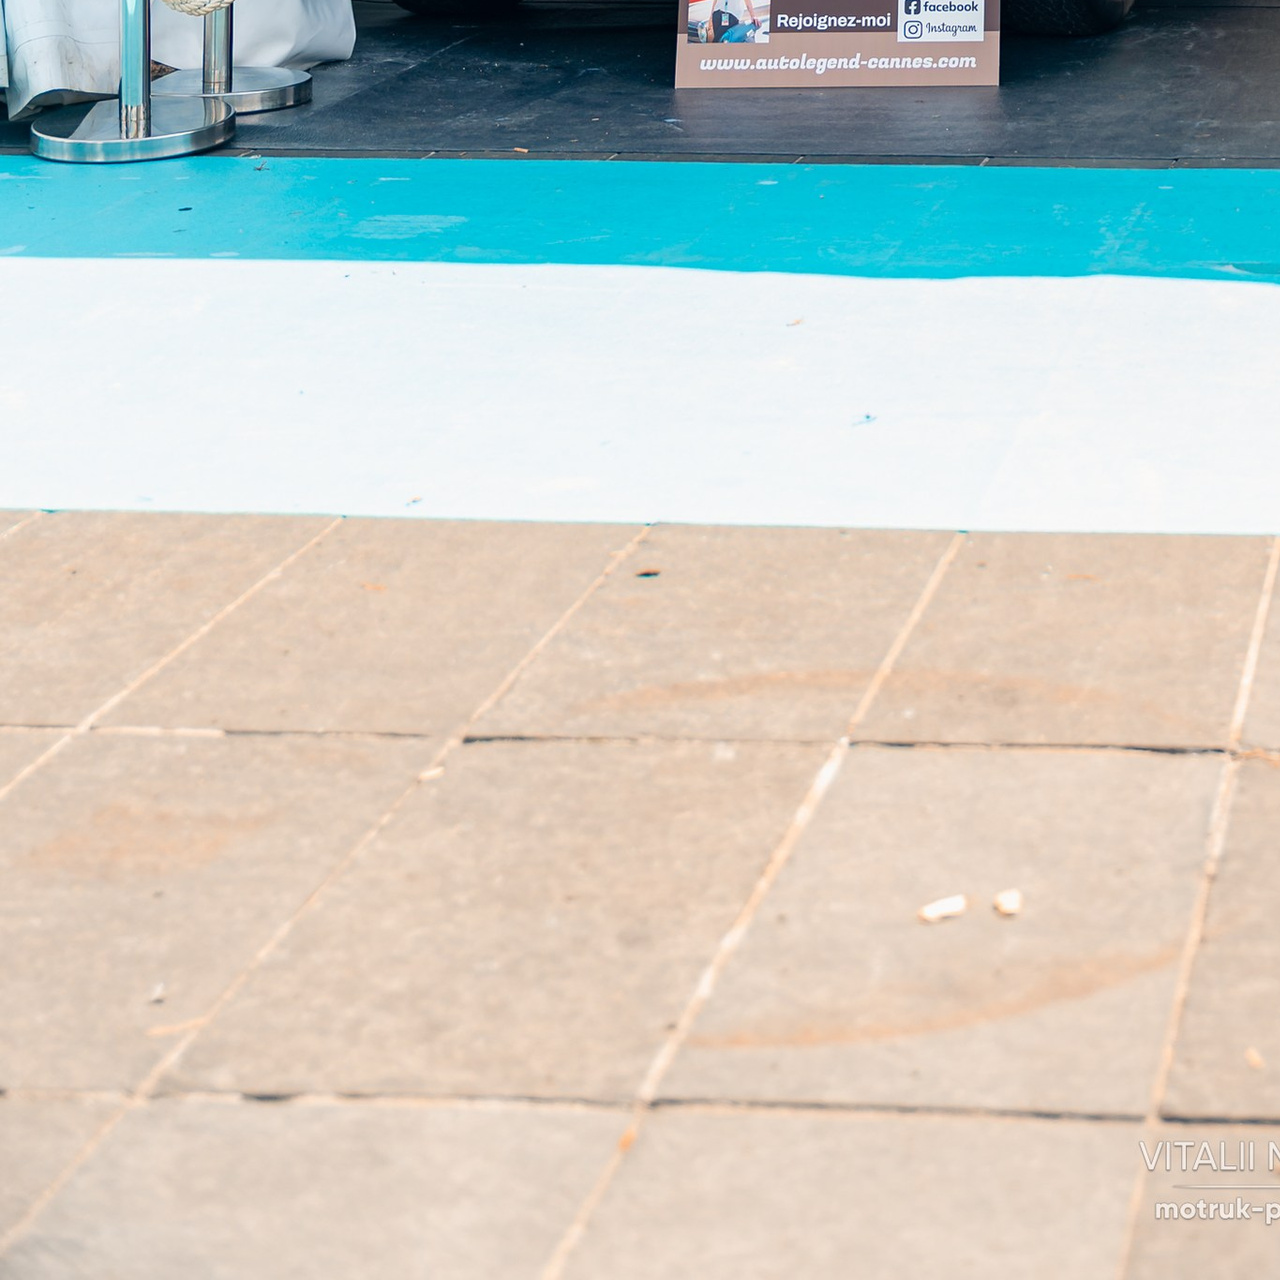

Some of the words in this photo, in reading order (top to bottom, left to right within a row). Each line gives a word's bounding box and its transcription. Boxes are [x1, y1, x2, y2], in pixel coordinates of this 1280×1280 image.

[923, 0, 979, 13] facebook
[776, 13, 892, 31] Rejoignez-moi
[925, 21, 978, 37] Instagram
[699, 53, 977, 74] www.autolegend-cannes.com
